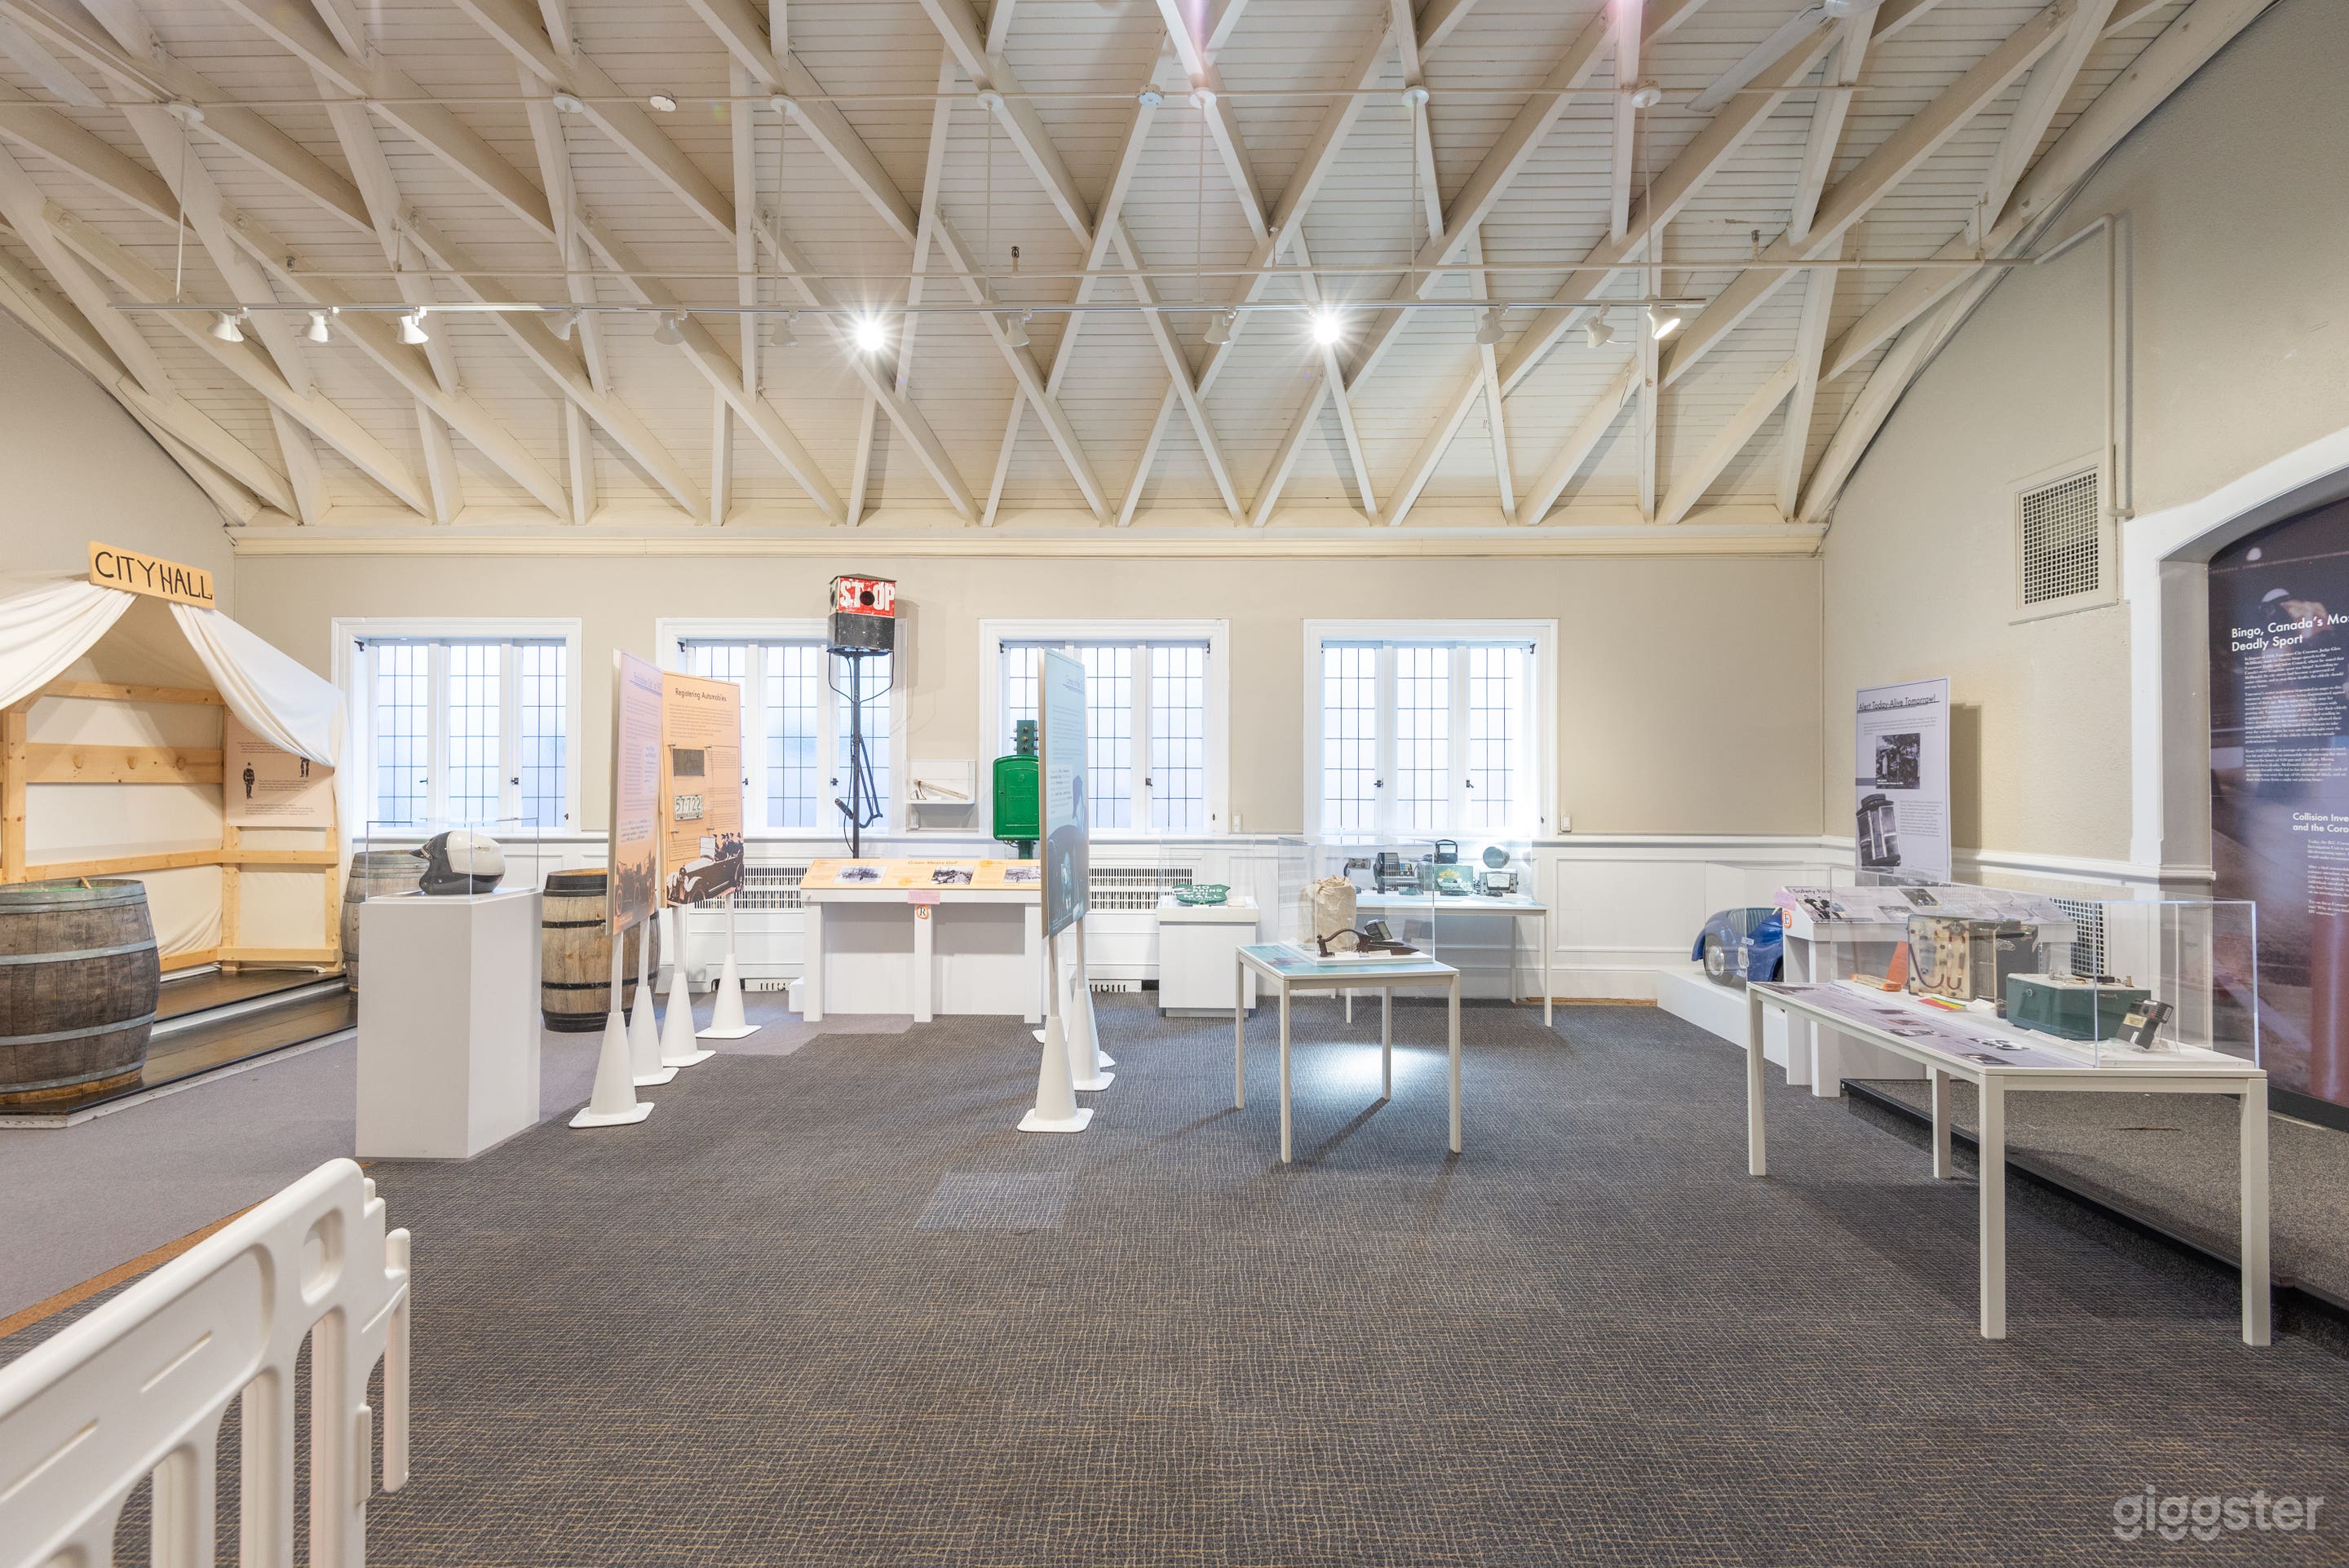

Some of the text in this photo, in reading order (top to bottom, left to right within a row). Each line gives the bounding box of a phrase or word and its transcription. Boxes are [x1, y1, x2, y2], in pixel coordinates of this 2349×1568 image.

[95, 551, 213, 600] CITY HALL
[839, 580, 896, 612] STOP
[2232, 613, 2349, 638] Bingo, Canada's Mo
[2232, 634, 2303, 651] Deadly Sport
[675, 687, 727, 702] Registering Automobiles
[2293, 812, 2329, 822] Collision
[2293, 824, 2308, 832] and
[2311, 824, 2325, 832] the
[919, 907, 927, 917] R
